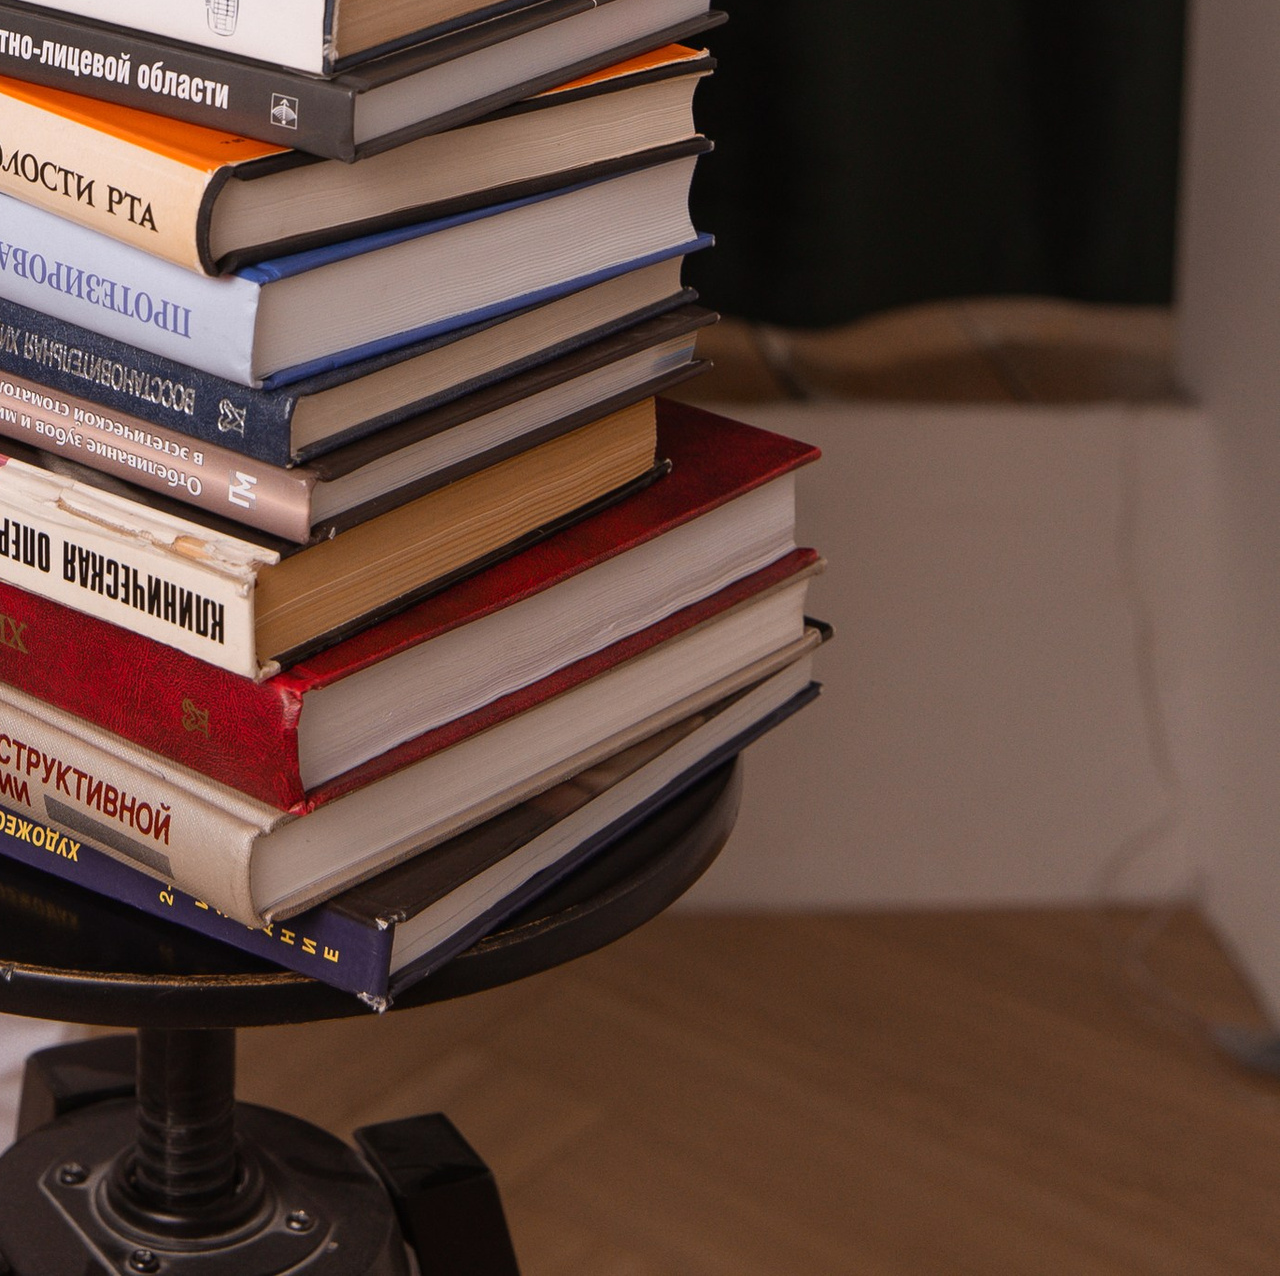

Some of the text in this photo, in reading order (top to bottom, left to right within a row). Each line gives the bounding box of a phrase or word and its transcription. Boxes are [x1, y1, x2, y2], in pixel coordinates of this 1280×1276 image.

[137, 60, 230, 110] области
[106, 184, 160, 233] РТА
[23, 331, 196, 416] ВОССТАНОВИТЕЛЬНАЯ
[21, 414, 32, 429] и
[35, 421, 83, 447] зубов
[73, 406, 190, 462] эстетической
[86, 438, 203, 496] Отбеливание
[193, 451, 204, 466] в
[63, 540, 225, 645] КЛИНИЧЕСКАЯ
